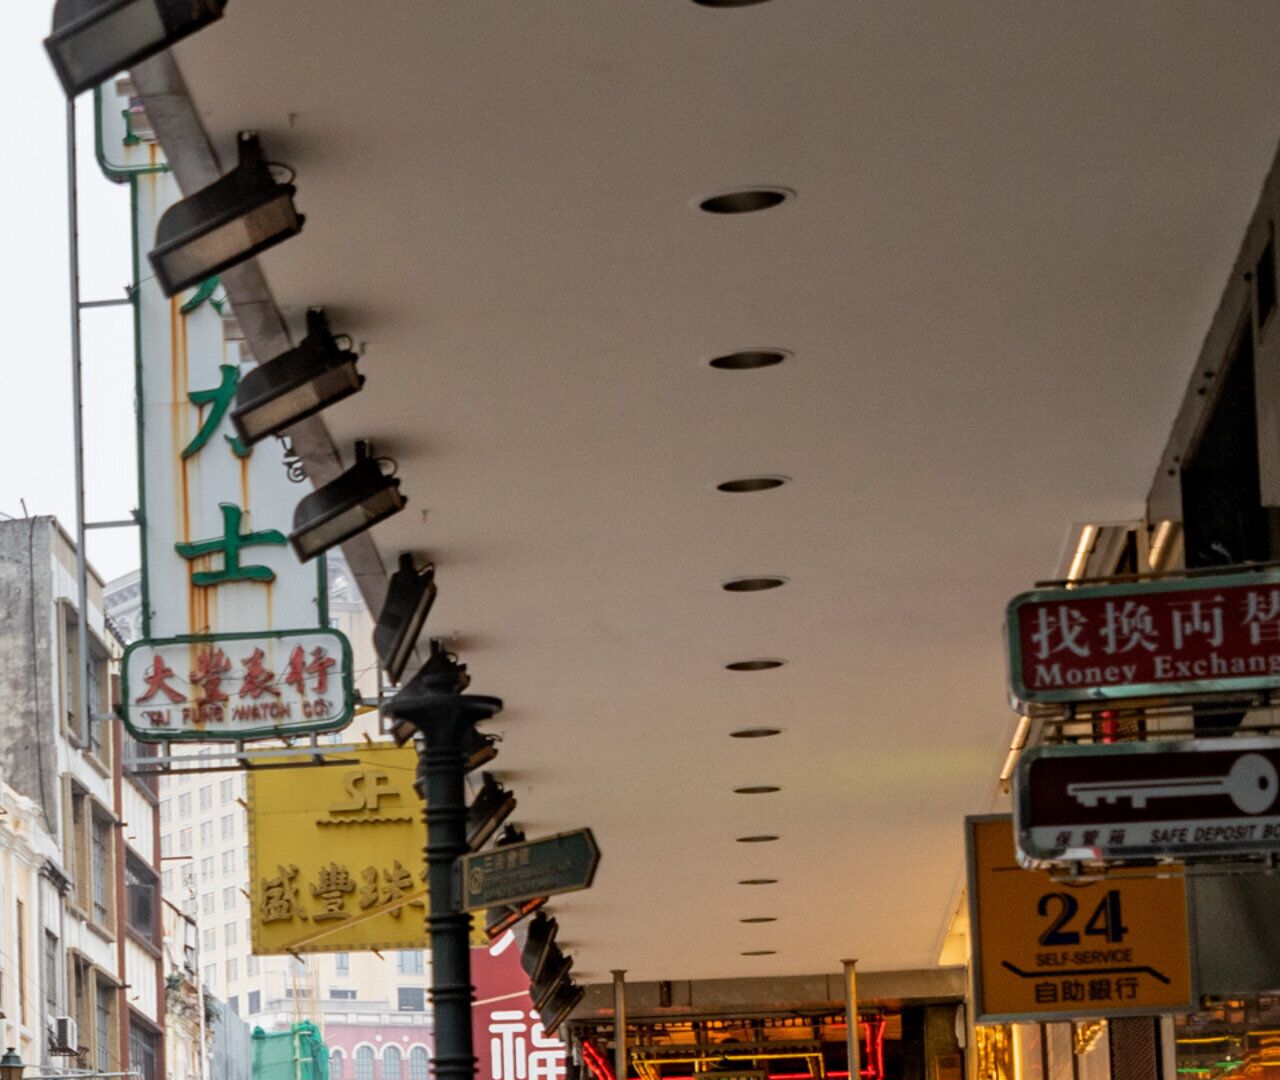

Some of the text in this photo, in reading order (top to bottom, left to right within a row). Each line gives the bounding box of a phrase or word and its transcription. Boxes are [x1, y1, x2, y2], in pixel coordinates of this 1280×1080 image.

[1034, 663, 1137, 687] Money
[144, 708, 171, 726] TAI
[183, 704, 223, 724] FUNG
[233, 701, 290, 722] WATCH
[329, 770, 400, 813] SF
[1150, 827, 1188, 844] SAFE
[1194, 824, 1258, 842] DEPOSIT
[260, 859, 428, 925] 盛豐珠
[1037, 889, 1128, 946] 24
[1035, 950, 1133, 967] SELF-SERVICE
[1035, 976, 1139, 1004] 自助銀行
